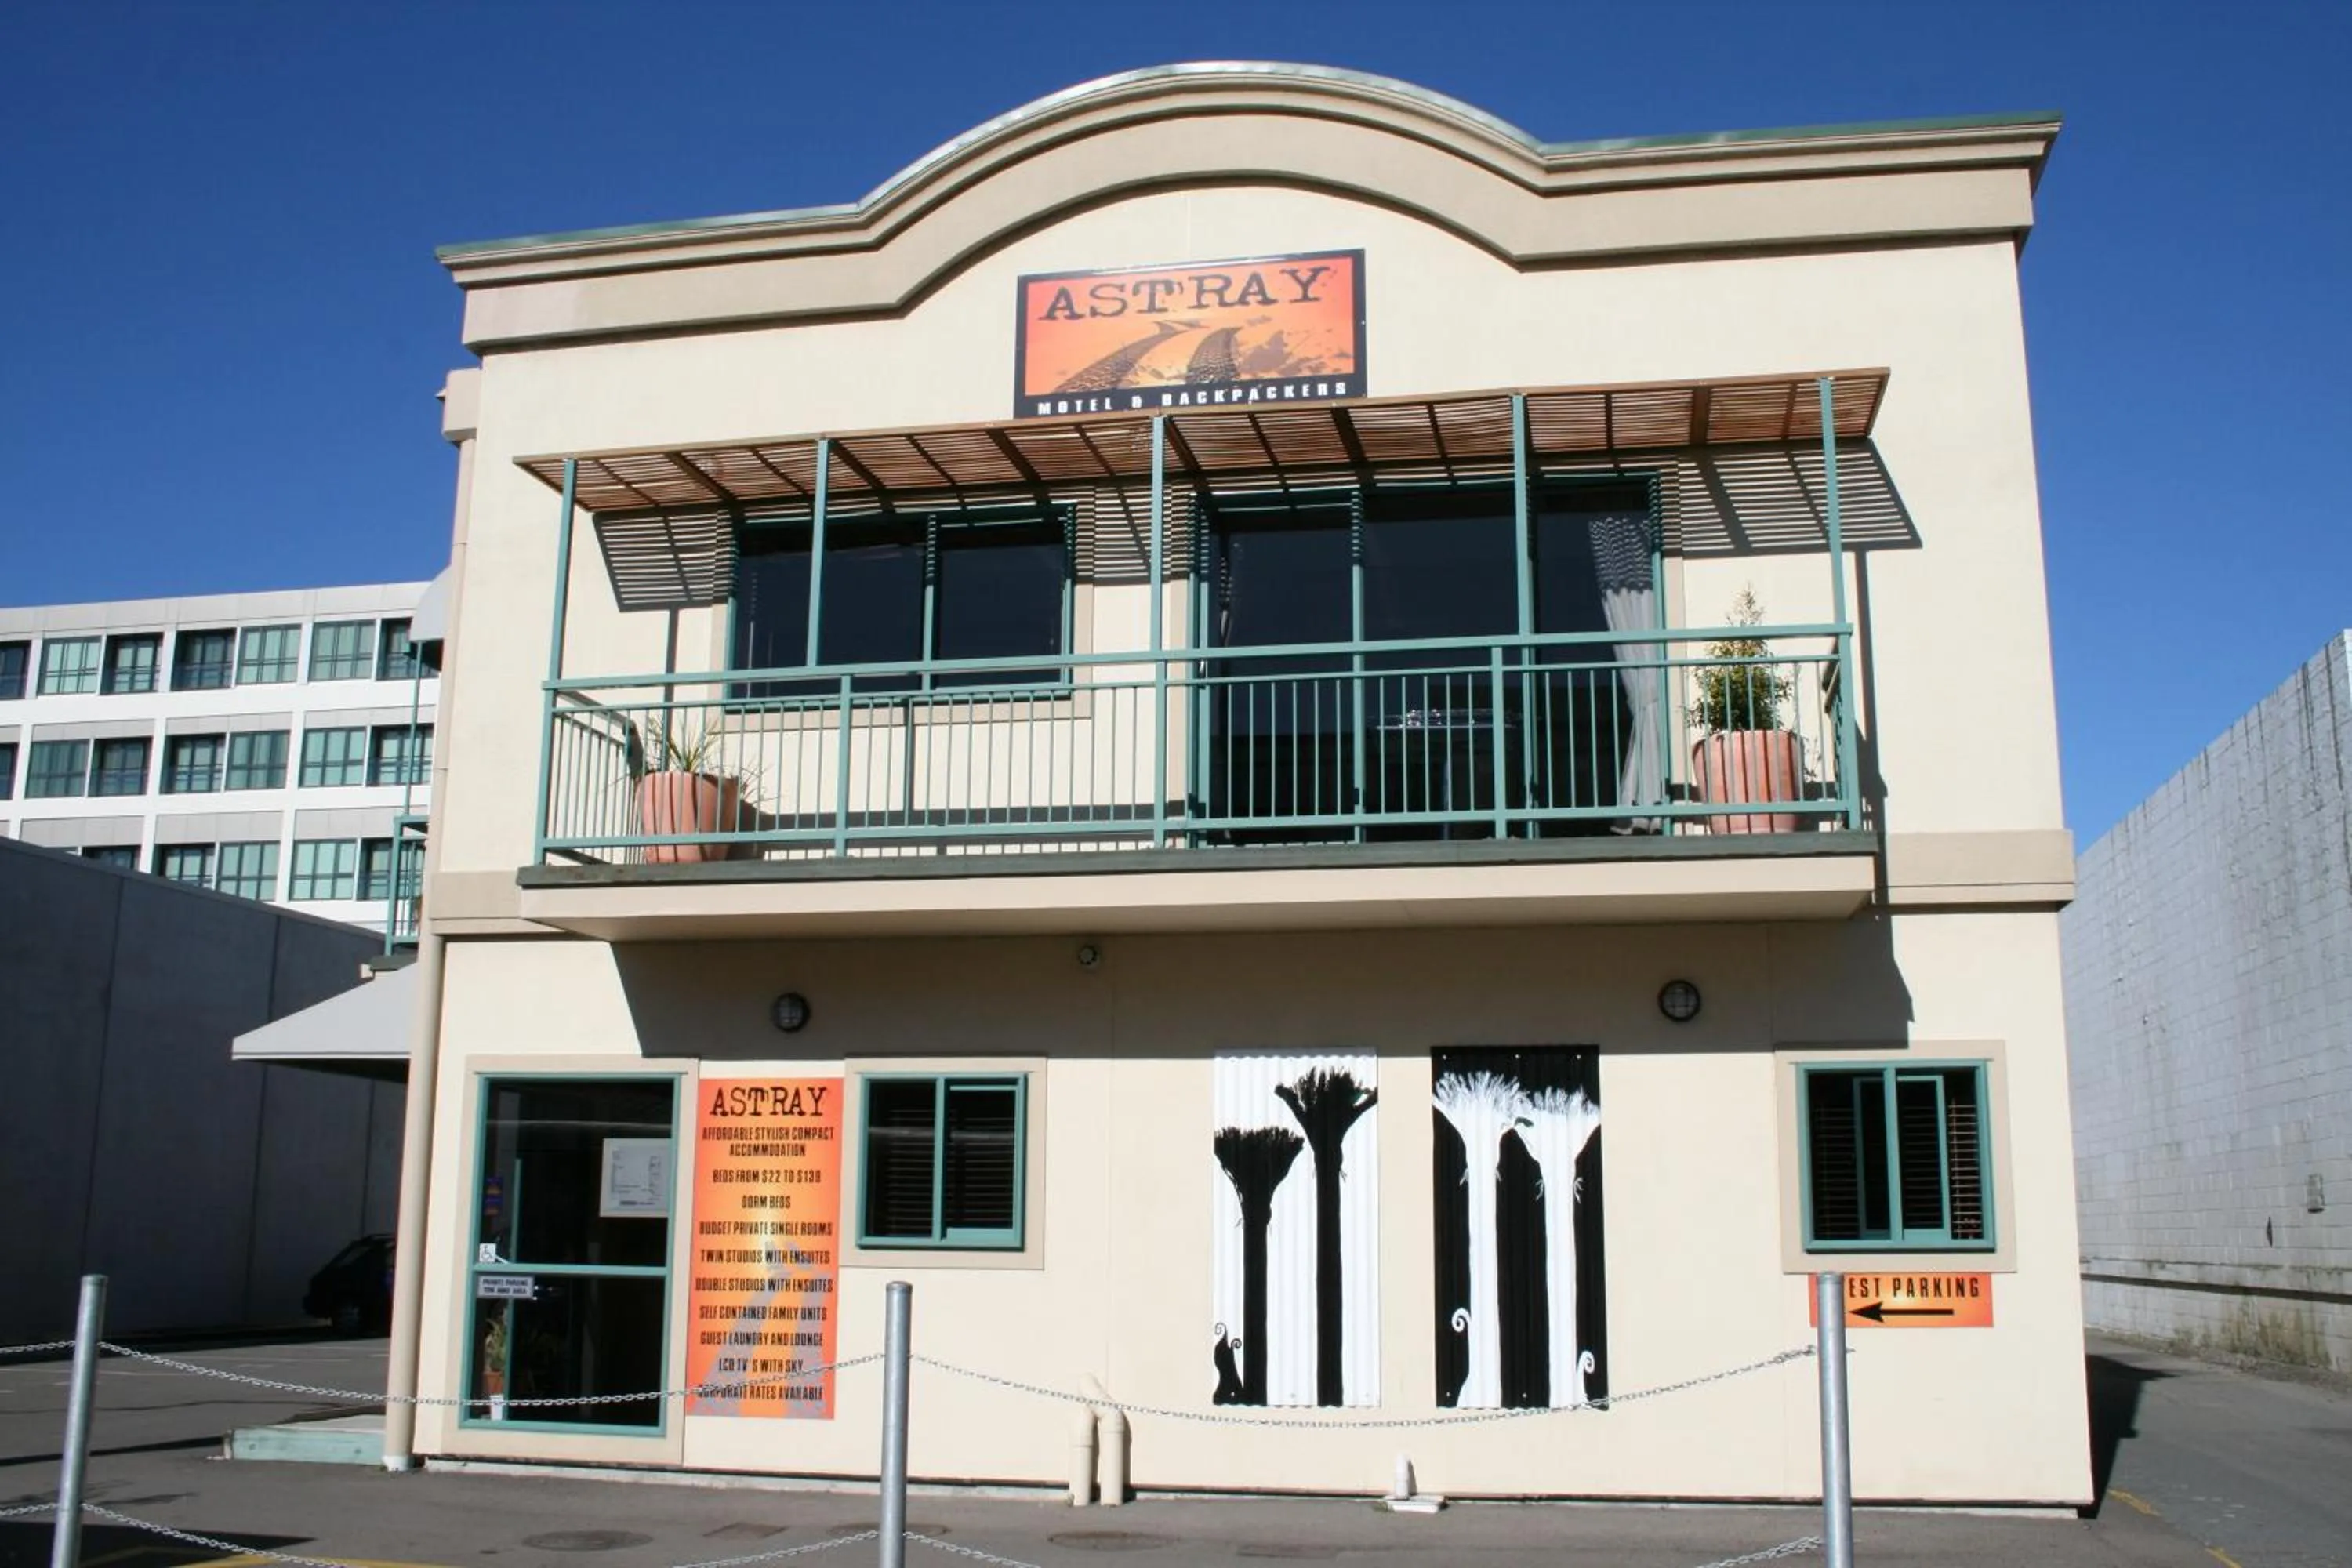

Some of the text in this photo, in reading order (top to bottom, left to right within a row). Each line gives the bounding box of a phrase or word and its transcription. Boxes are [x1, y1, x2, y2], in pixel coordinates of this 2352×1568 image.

[1038, 266, 1330, 321] ASTRAY
[1037, 397, 1113, 416] MOTEL
[1161, 382, 1347, 407] BACKPACKERS
[709, 1086, 828, 1117] ASTRAY
[702, 1127, 834, 1141] AFFORDABLE STYLISH COMPACT
[729, 1143, 806, 1157] ACCOMMODATION
[713, 1169, 734, 1184] BEDS
[735, 1169, 760, 1184] FROM
[761, 1169, 781, 1184] $22
[783, 1169, 795, 1184] TO
[742, 1195, 791, 1209] DORM BEDS
[699, 1221, 833, 1236] BUDGET PRIVATE SINGLE ROOMS
[701, 1249, 830, 1264] TWIN STUDIOS WITH ENSUITES
[695, 1278, 833, 1292] DOUBLE STUDIOS WITH ENSUITES
[1892, 1277, 1980, 1298] PARKING
[699, 1305, 827, 1321] SELF CONTAINED FAMILY UNITS
[700, 1330, 823, 1346] GUEST LAUNDRY AND LOUNGE
[719, 1357, 735, 1373] LCD
[760, 1357, 782, 1373] WITH
[785, 1357, 804, 1373] SKY
[750, 1385, 777, 1399] RATES
[779, 1386, 823, 1401] AVAILABLE
